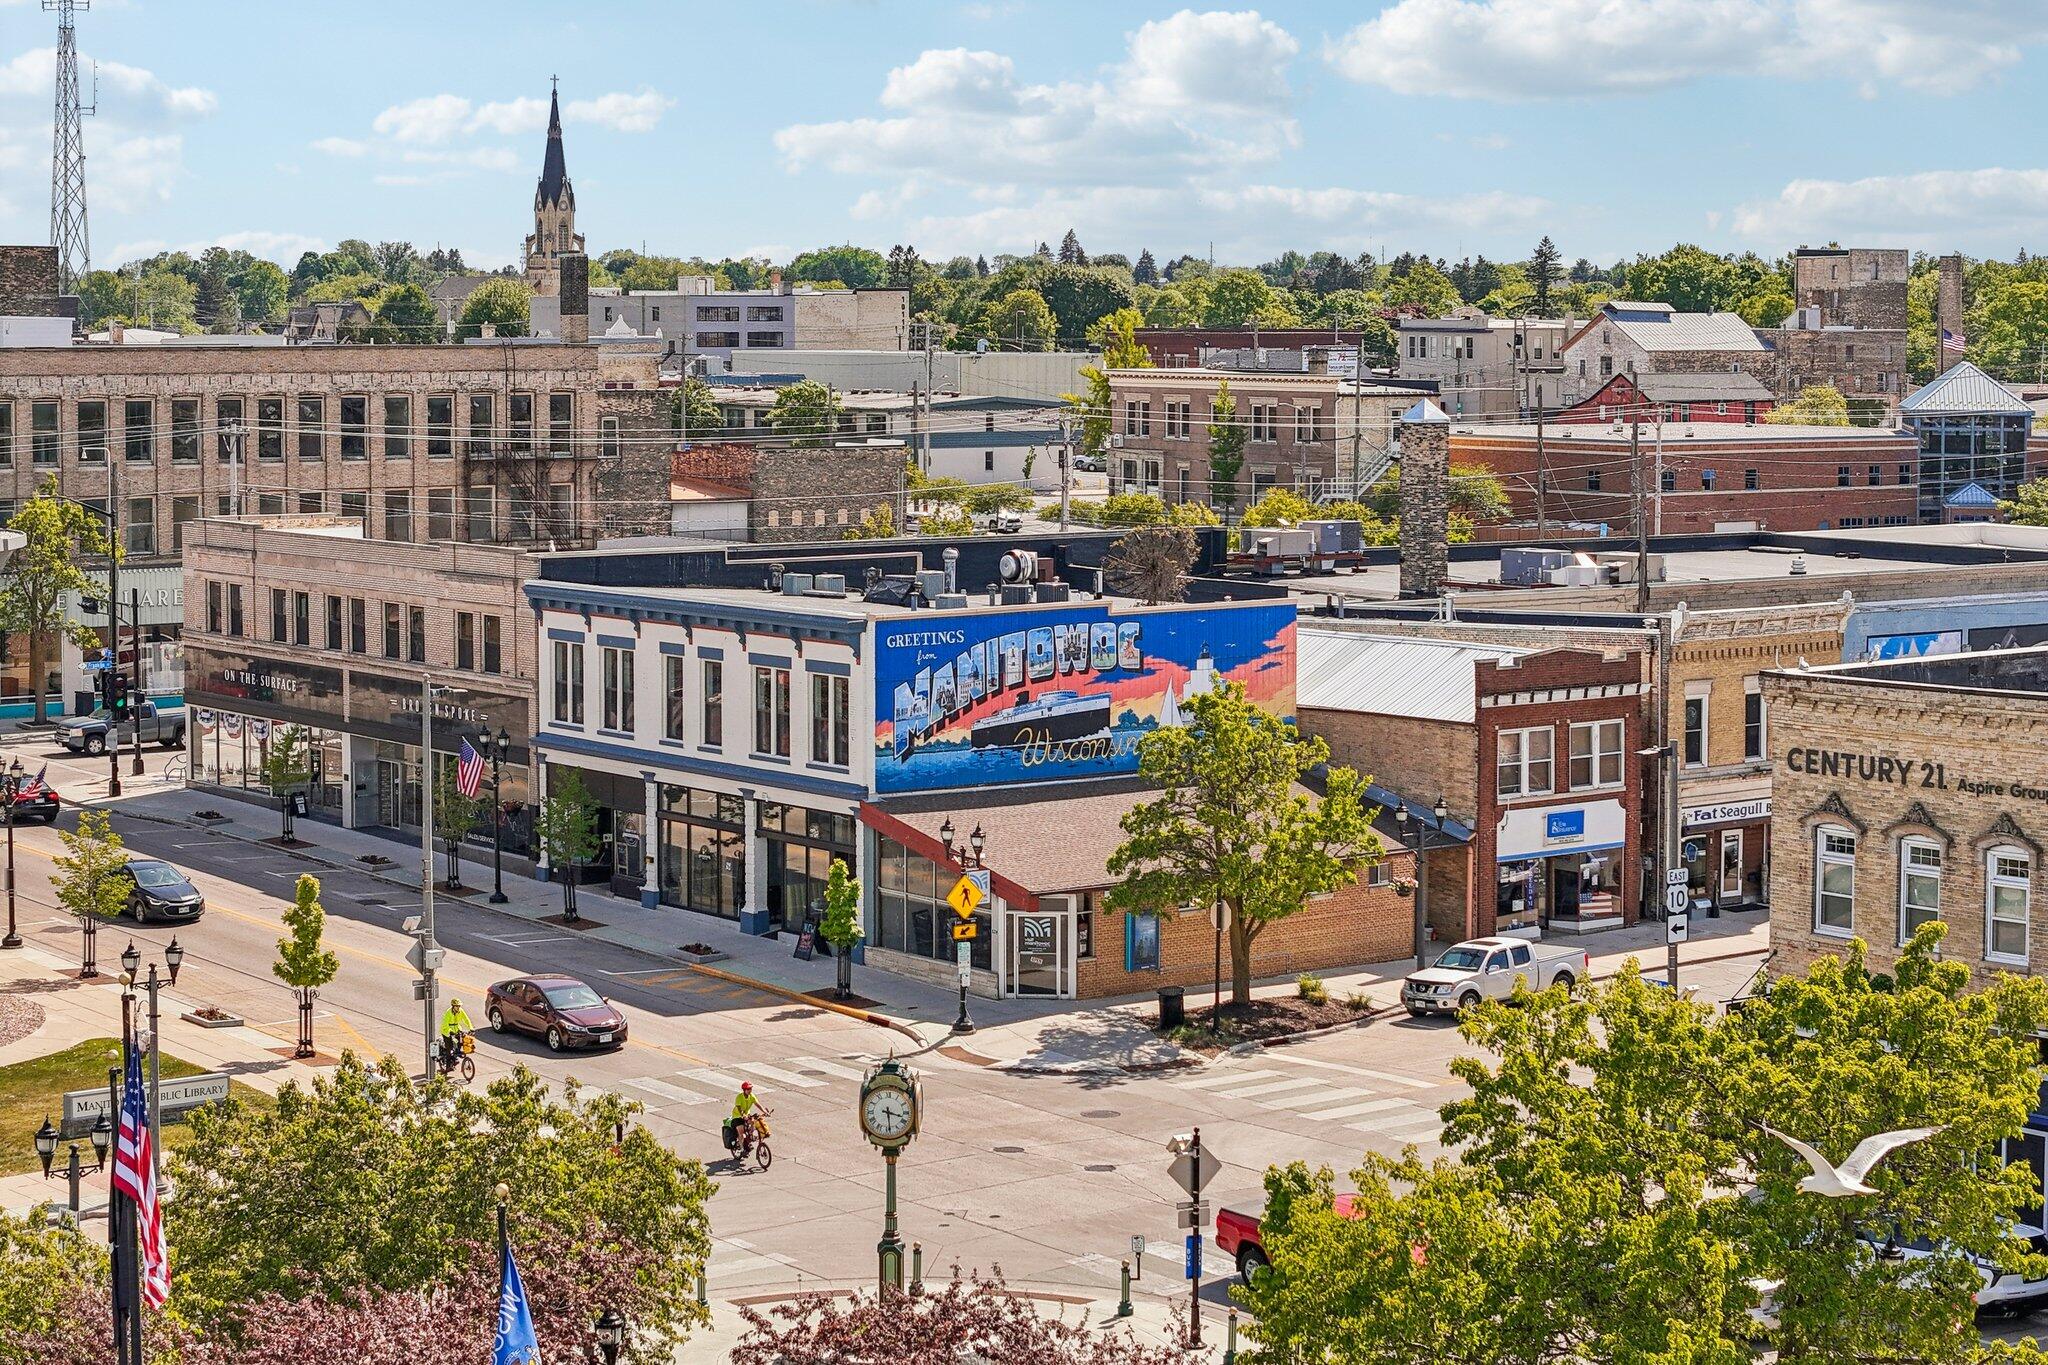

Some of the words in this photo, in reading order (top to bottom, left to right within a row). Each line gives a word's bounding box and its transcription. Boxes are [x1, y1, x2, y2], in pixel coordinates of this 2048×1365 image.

[886, 629, 965, 648] GREETINGS
[916, 649, 938, 665] from
[224, 669, 236, 682] ON
[239, 671, 256, 685] THE
[260, 675, 297, 692] SURFACE
[894, 622, 1143, 760] MANITOWOC
[444, 705, 475, 722] SPOKE
[1786, 747, 1914, 785] CENTURY
[1957, 778, 2003, 797] Aspire
[1693, 808, 1717, 822] Fat
[1719, 802, 1762, 818] Seagull
[1669, 871, 1686, 882] EAST
[1670, 890, 1685, 907] 10
[184, 1085, 224, 1098] LIBRARY
